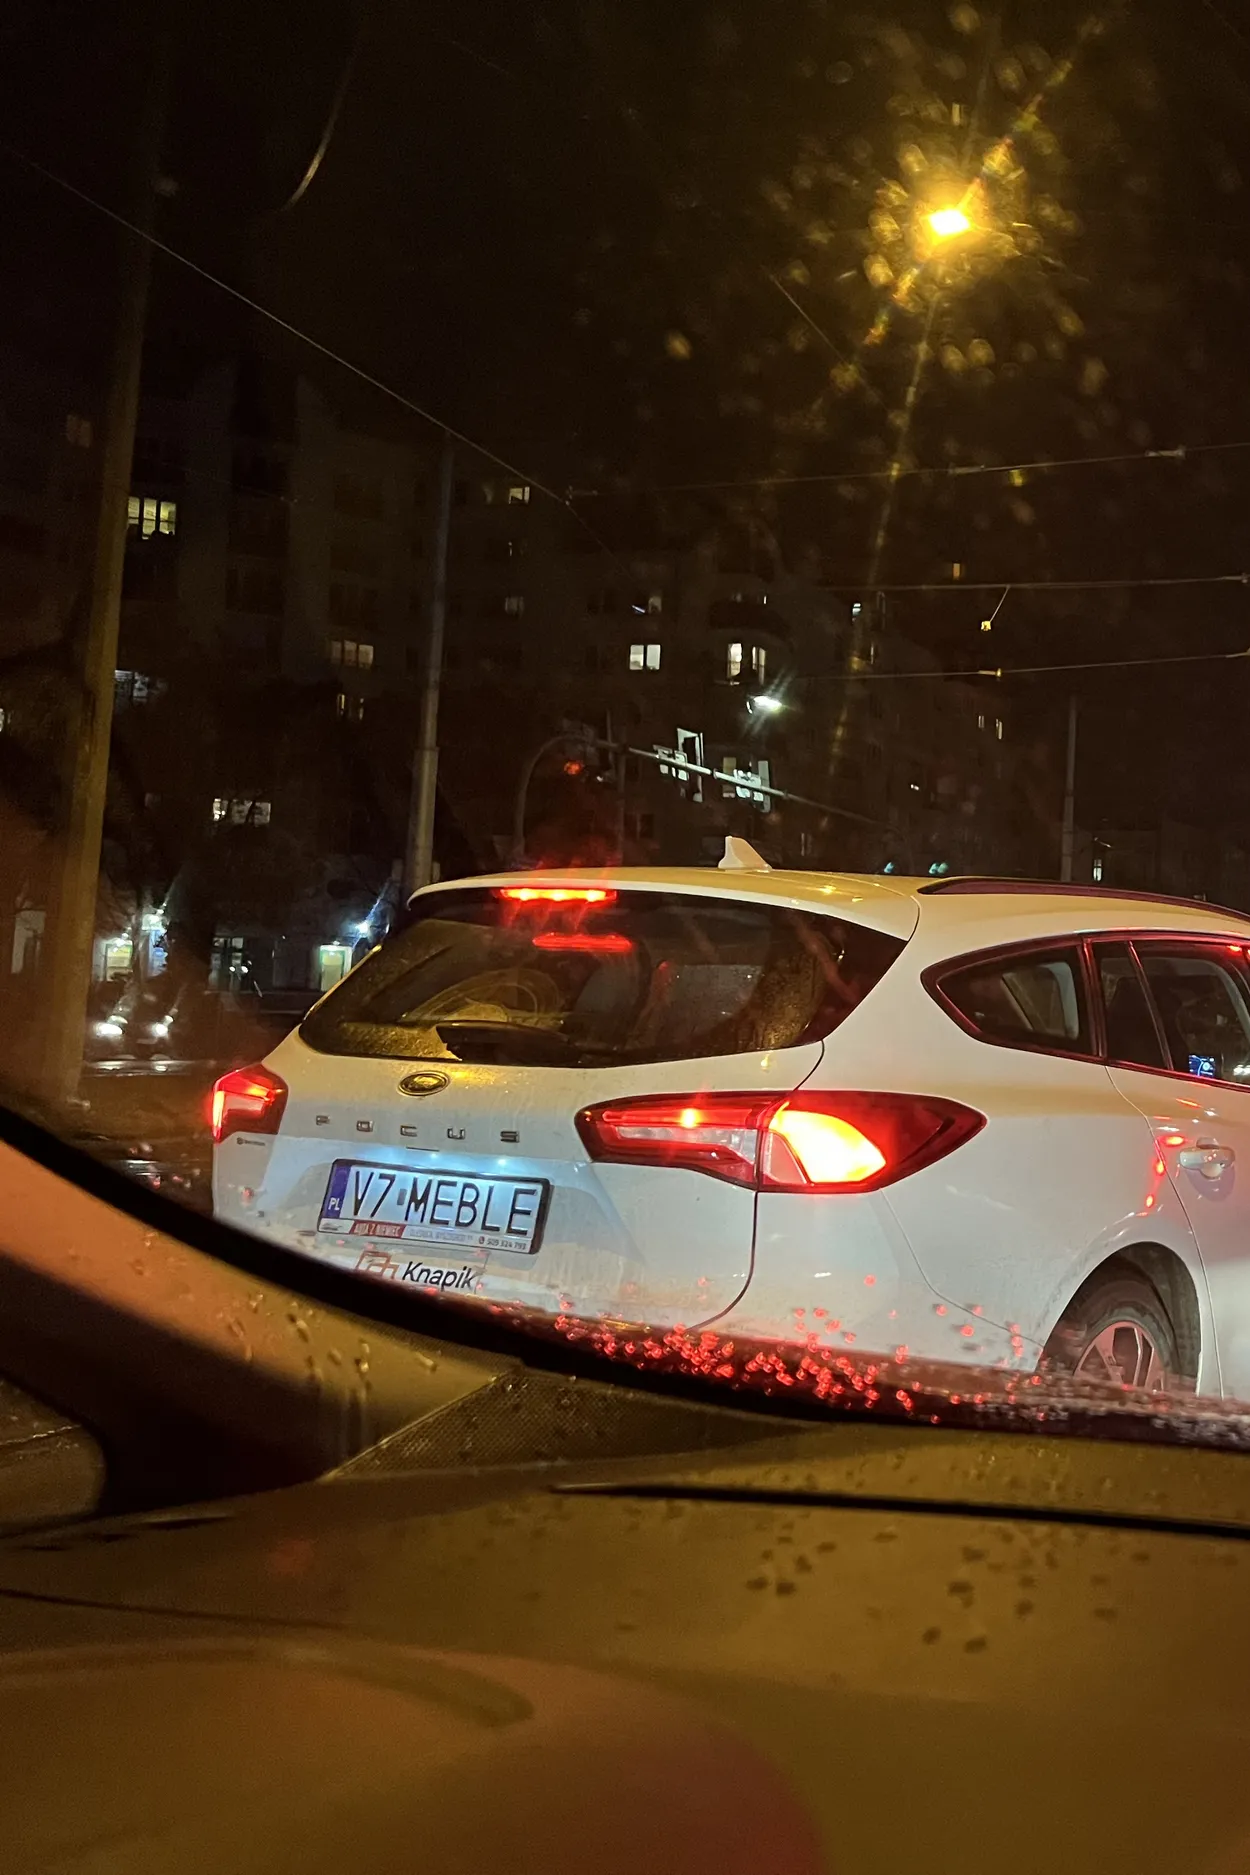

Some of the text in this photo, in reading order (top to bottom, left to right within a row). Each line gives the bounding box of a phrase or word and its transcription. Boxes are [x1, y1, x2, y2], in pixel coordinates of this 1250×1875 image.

[315, 1114, 520, 1144] FOCUS
[328, 1197, 341, 1211] PL
[353, 1170, 537, 1236] V7 MEBLE
[402, 1261, 476, 1292] Knapik
